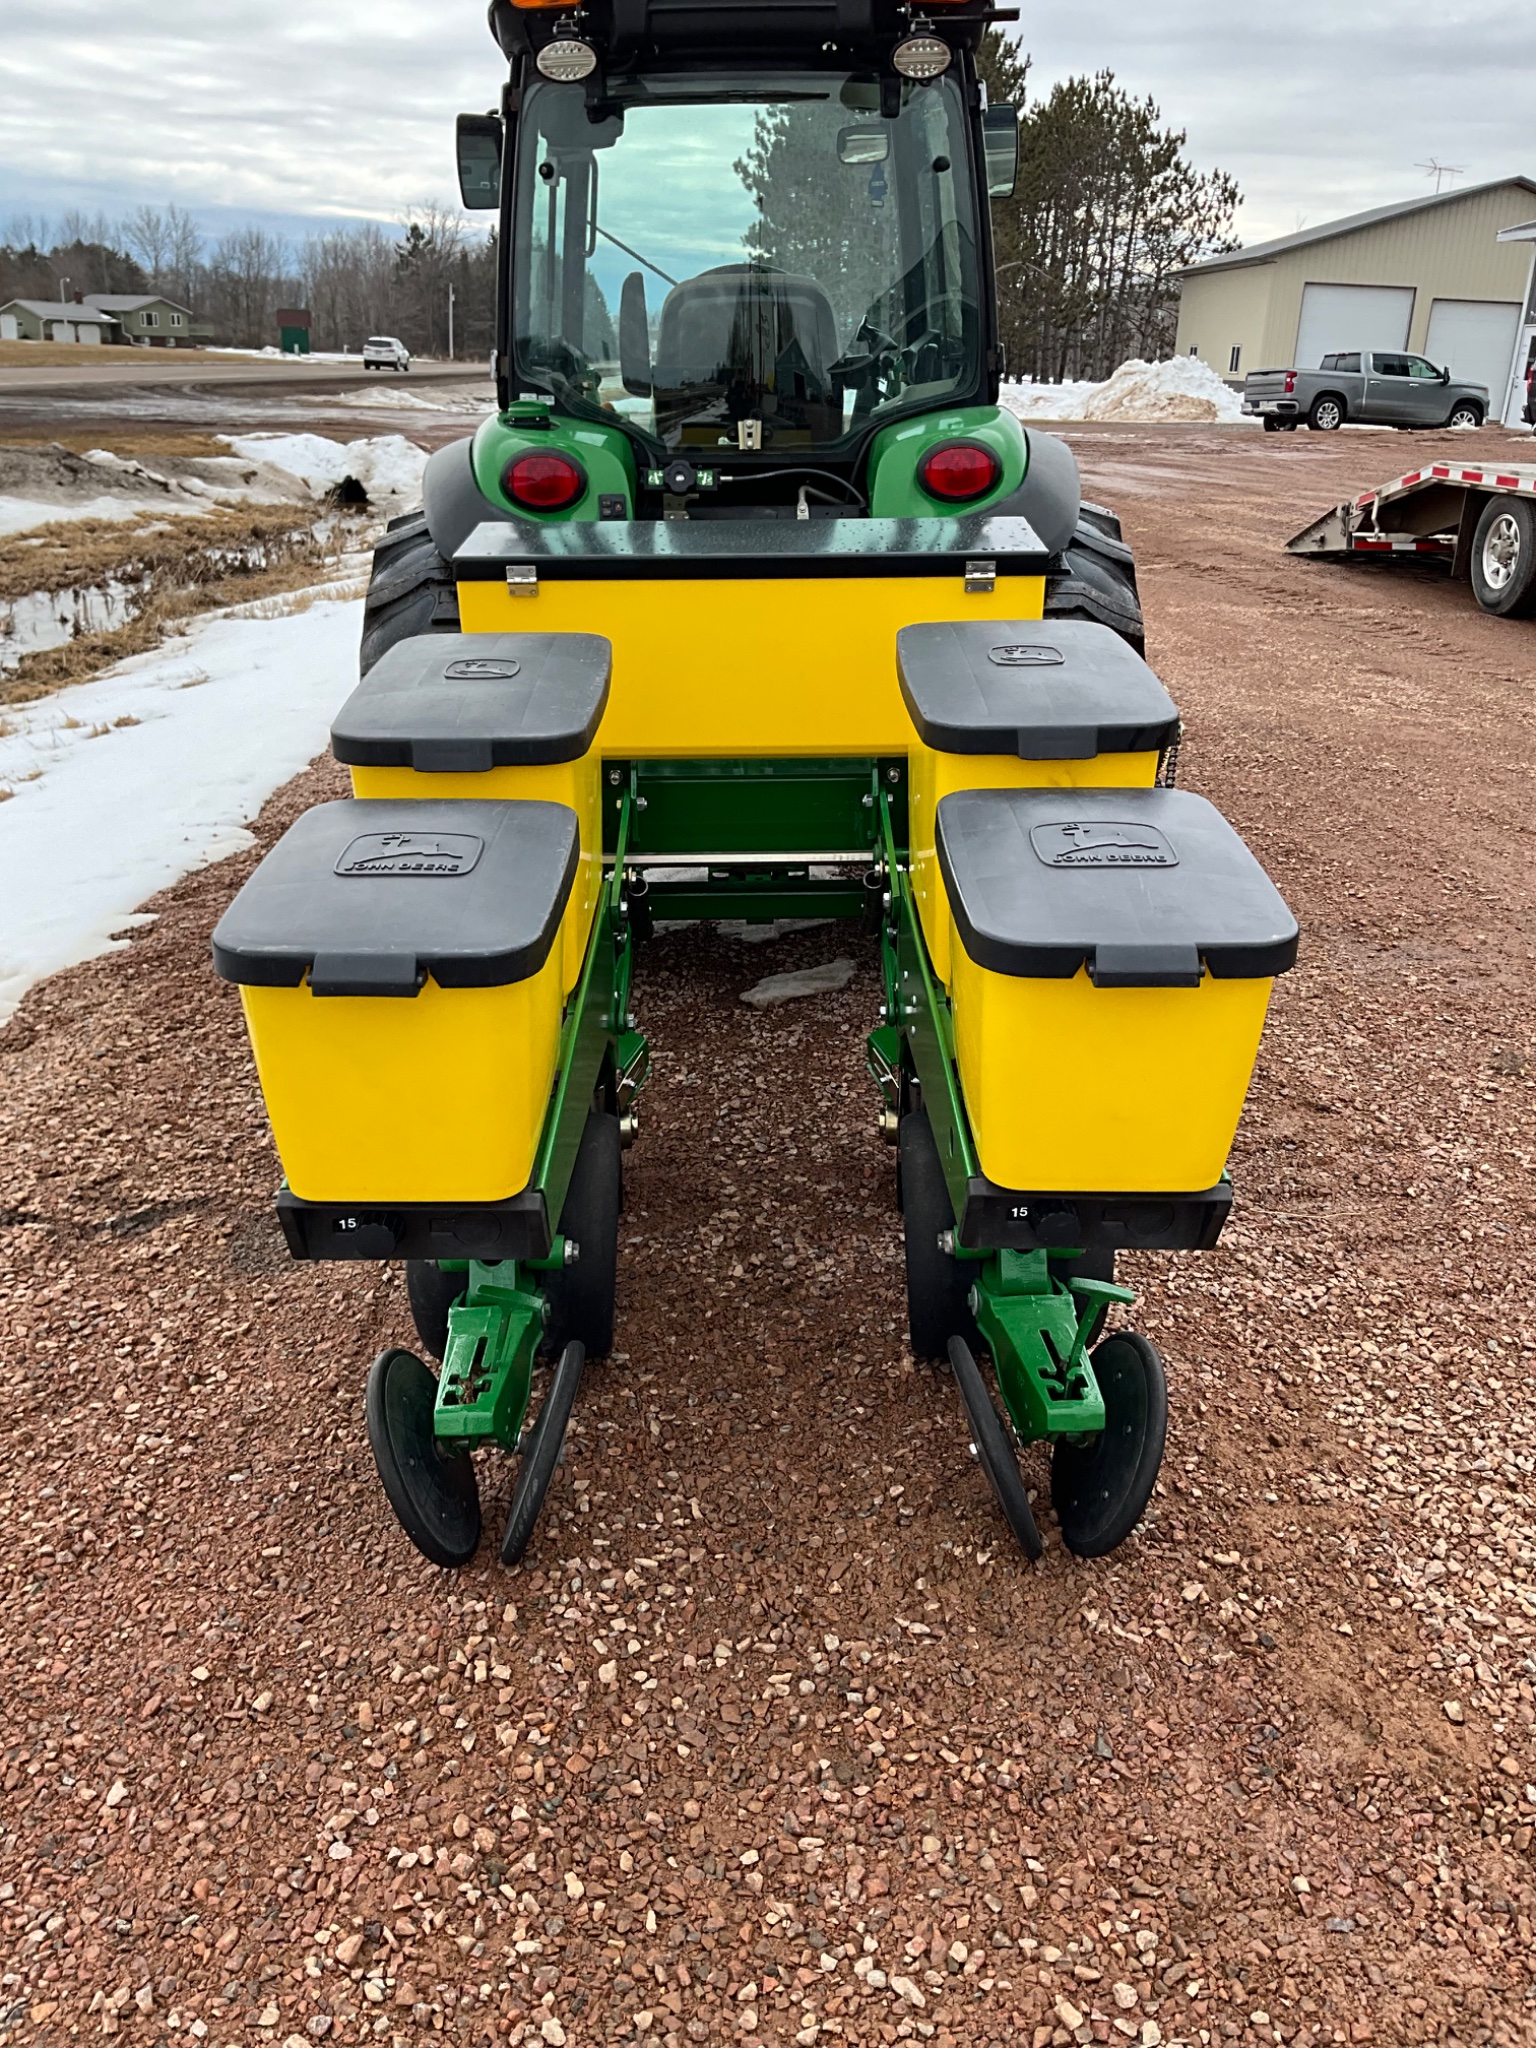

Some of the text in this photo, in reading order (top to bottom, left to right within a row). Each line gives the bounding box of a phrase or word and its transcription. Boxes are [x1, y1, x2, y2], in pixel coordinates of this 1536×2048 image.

[1052, 854, 1167, 863] JOHN DEERE
[344, 862, 460, 872] JOHN DEERE
[1011, 1207, 1028, 1217] 15
[338, 1218, 357, 1229] 15
